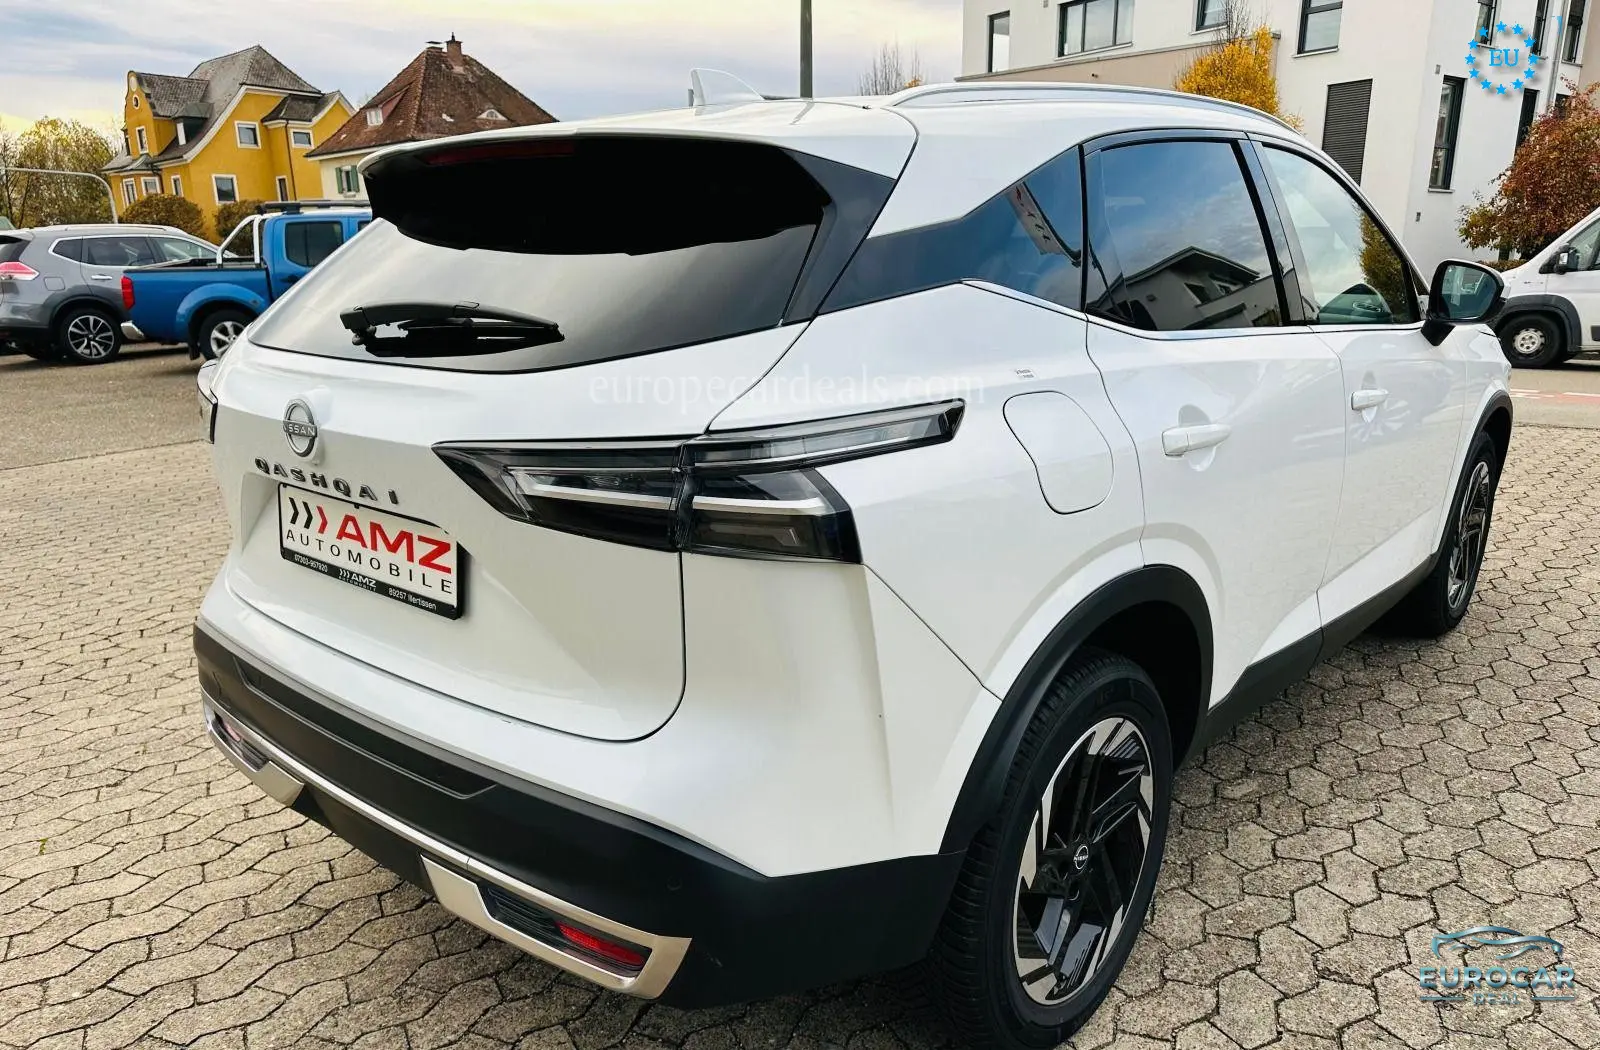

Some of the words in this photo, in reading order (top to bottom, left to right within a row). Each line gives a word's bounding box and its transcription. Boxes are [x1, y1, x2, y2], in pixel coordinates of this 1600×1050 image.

[254, 457, 399, 505] QASHQAI
[286, 529, 453, 595] AUTOMOBILE
[335, 514, 452, 575] AMZ
[350, 572, 377, 588] AMZ
[388, 587, 407, 600] 89257
